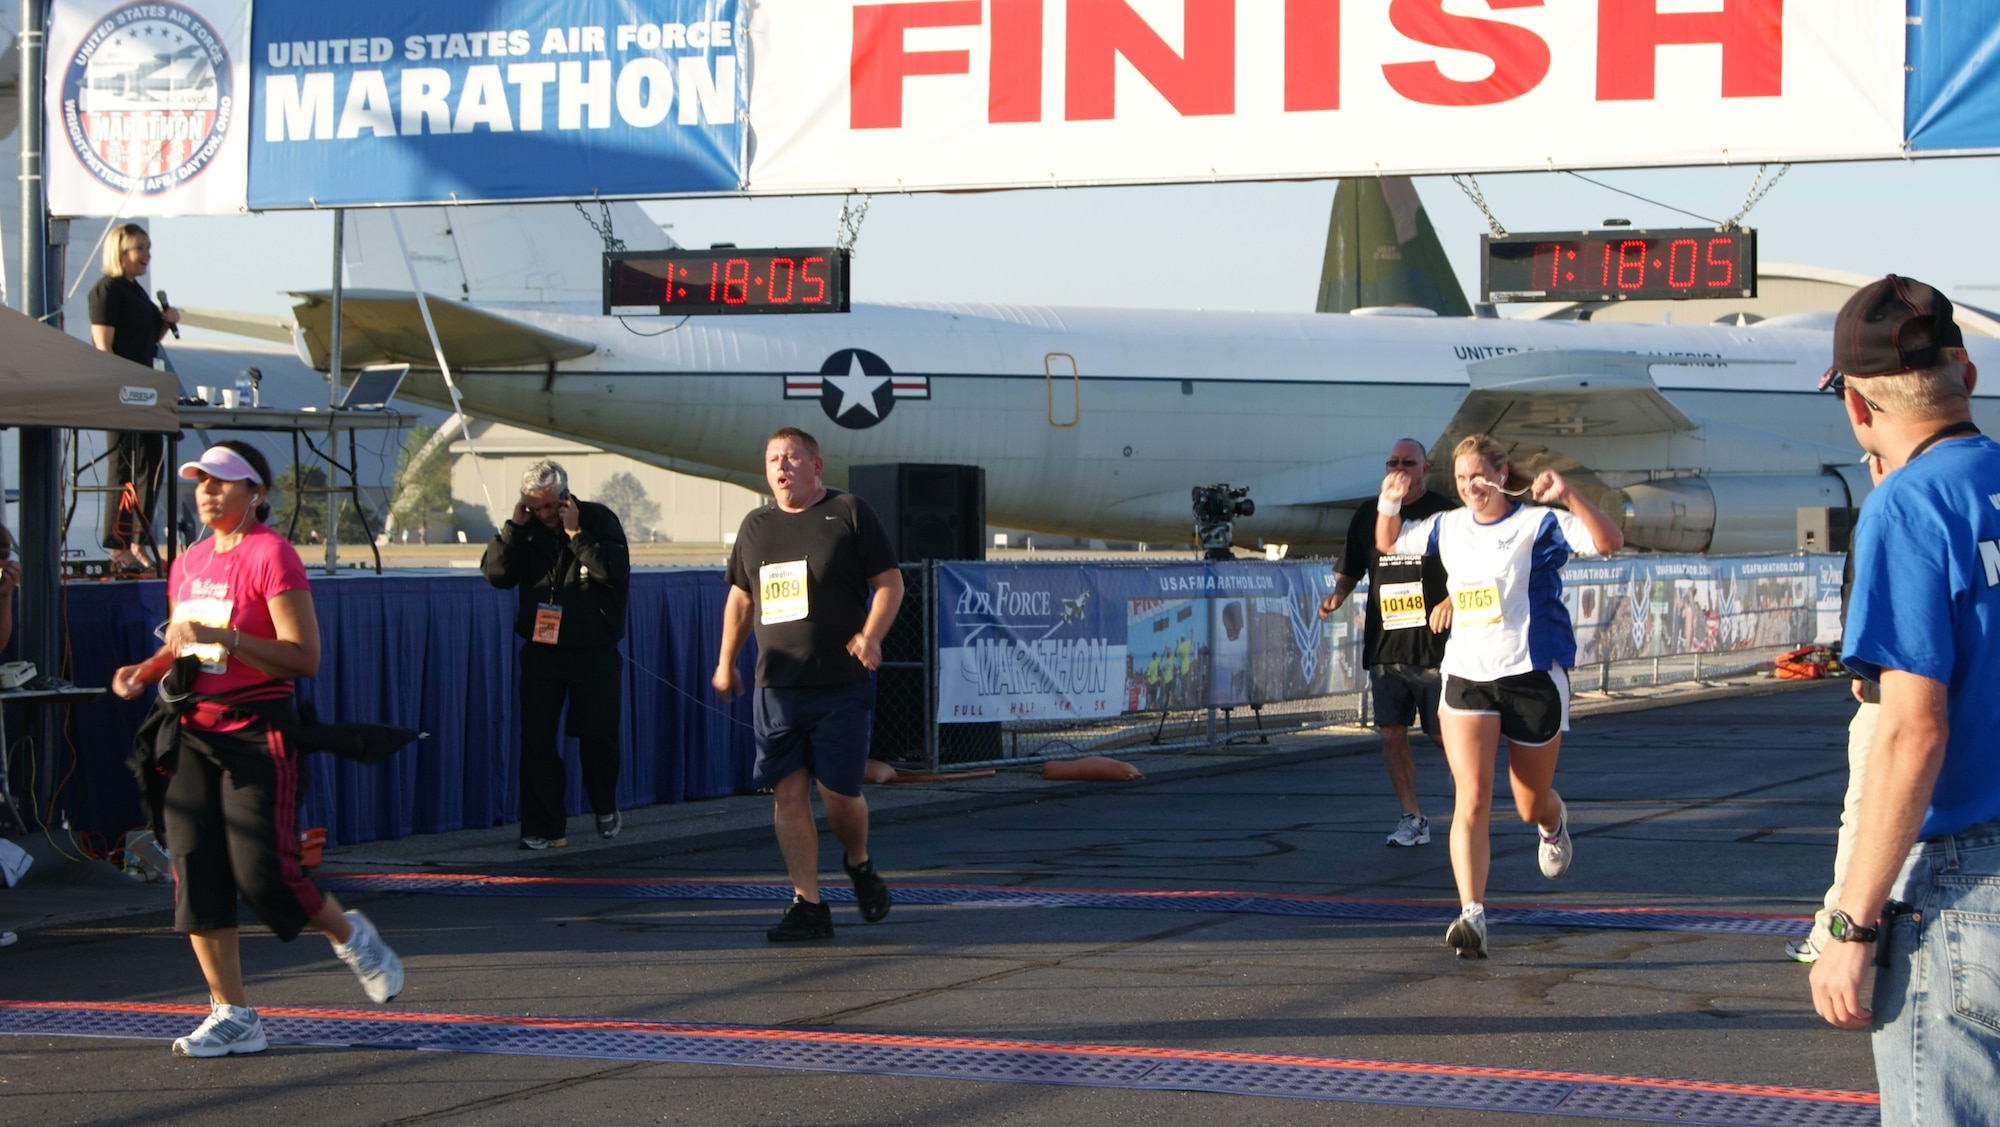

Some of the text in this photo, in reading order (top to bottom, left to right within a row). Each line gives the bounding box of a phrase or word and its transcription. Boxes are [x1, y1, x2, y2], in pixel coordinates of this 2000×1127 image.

[75, 5, 224, 66] UNITED STATES AIR FORCE
[268, 21, 732, 67] UNITED STATES AIR FORCE
[848, 0, 1784, 129] FINISH
[265, 55, 736, 142] MARATHON
[64, 98, 146, 191] WRIGHT-PATTERSN
[147, 176, 171, 191] AFB
[178, 136, 224, 178] DAYTON,
[215, 95, 232, 131] OHIO
[91, 115, 206, 142] MARATHON
[1453, 346, 1518, 360] UNITE
[1379, 554, 1422, 562] MARATHON
[955, 581, 1051, 616] AIR FORCE
[1159, 576, 1274, 591] USAFMARATHON.COM
[1459, 588, 1493, 609] 9765
[1382, 596, 1423, 612] 10148
[976, 637, 1108, 696] MARATHON
[954, 704, 984, 716] FULL
[1010, 702, 1036, 714] HALF
